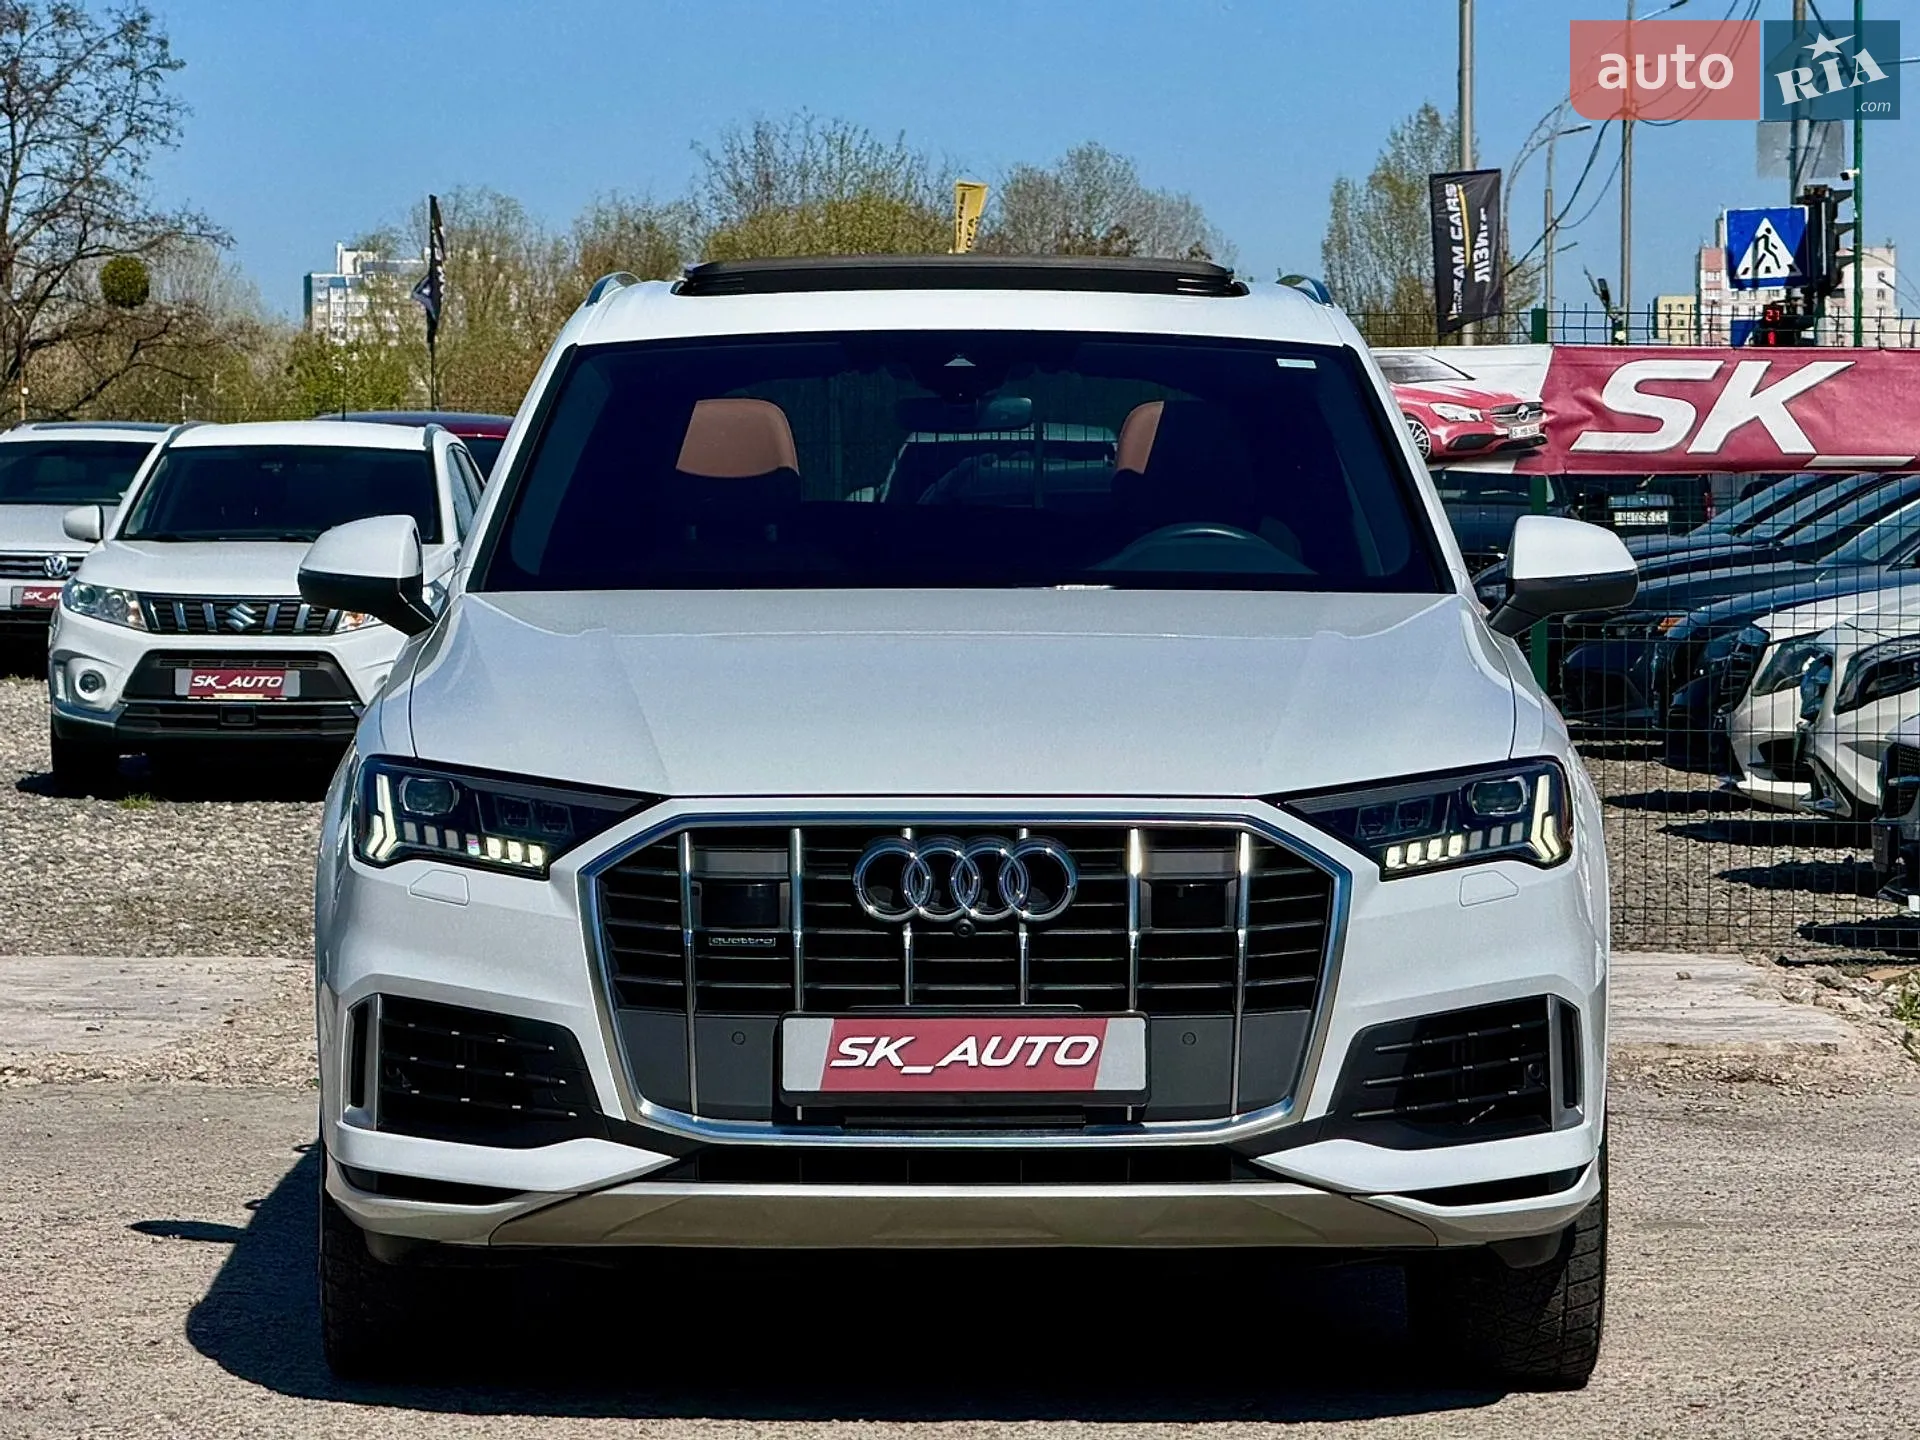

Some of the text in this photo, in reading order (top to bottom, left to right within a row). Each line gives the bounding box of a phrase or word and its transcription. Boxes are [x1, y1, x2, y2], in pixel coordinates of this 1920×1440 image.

[1445, 183, 1464, 240] CARS
[22, 591, 63, 602] SK_A
[191, 675, 283, 689] SK_AUTO
[711, 937, 773, 946] quattro
[829, 1035, 1100, 1074] SK_AUTO
